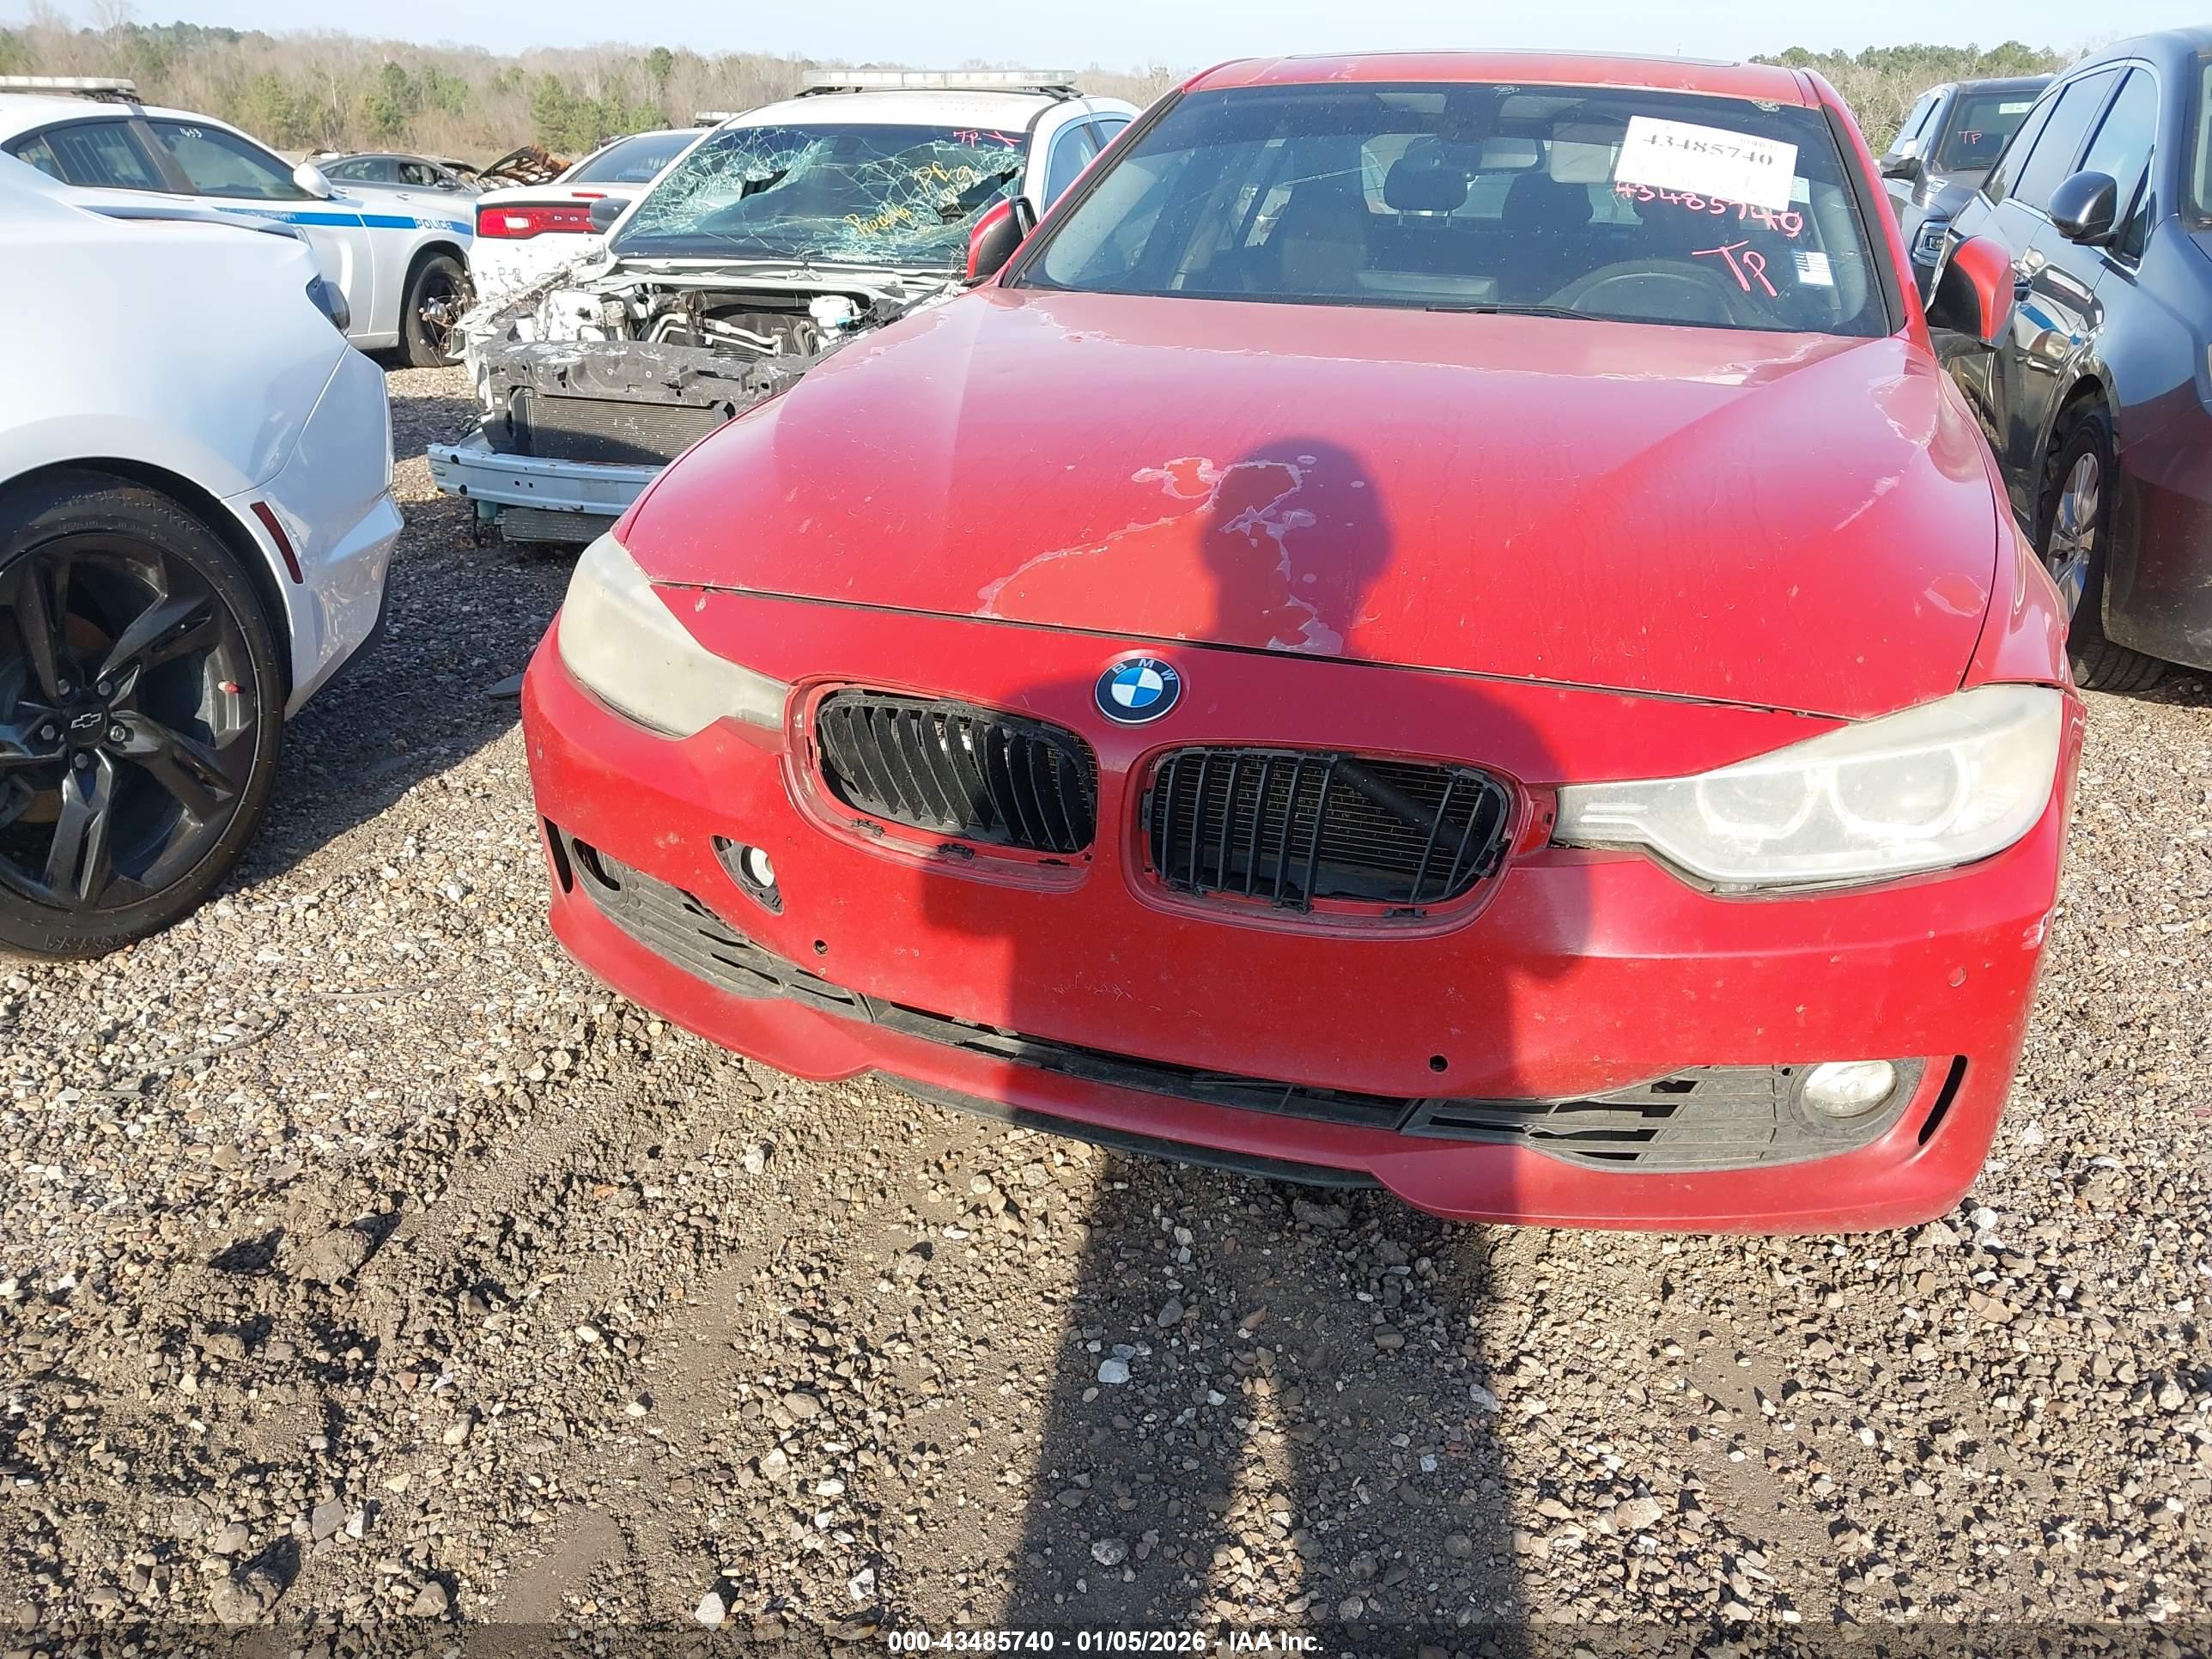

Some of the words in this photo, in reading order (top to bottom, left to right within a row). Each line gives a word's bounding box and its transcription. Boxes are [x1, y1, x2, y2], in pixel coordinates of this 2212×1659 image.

[1957, 130, 1983, 145] TP
[415, 218, 454, 231] POLICE
[1110, 658, 1177, 682] BMW
